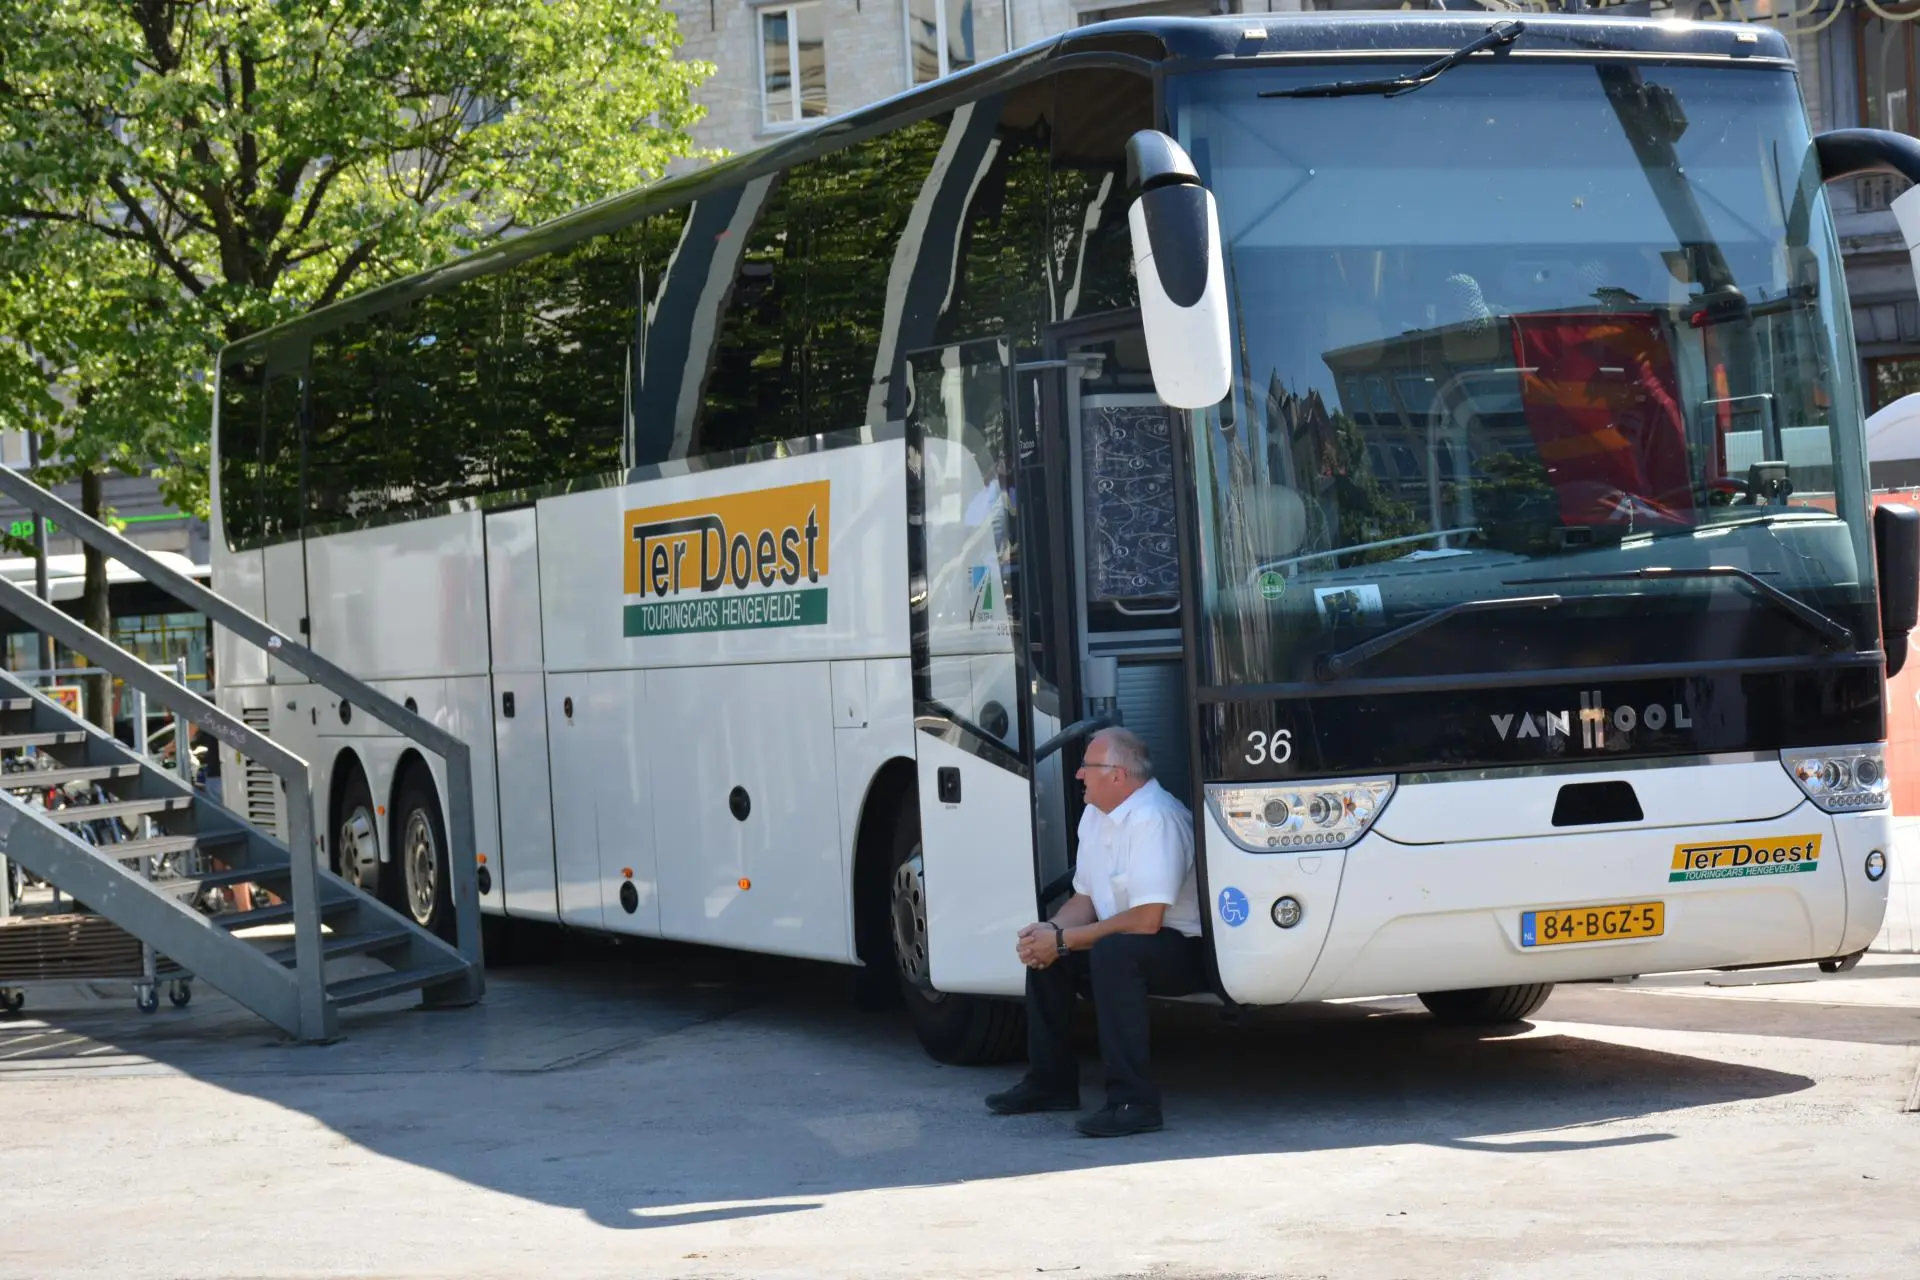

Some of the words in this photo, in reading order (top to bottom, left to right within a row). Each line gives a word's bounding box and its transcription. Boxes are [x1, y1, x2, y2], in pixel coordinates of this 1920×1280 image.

[633, 517, 698, 598] Ter
[700, 504, 819, 593] Doest
[641, 600, 718, 631] TOURINGCARS
[722, 593, 801, 626] HENGEVELDE
[1490, 710, 1571, 742] VAN
[1579, 690, 1693, 749] HOOL
[1245, 728, 1292, 765] 36
[1682, 847, 1727, 870] Ter
[1732, 842, 1814, 867] Doest
[1684, 867, 1744, 880] TOURINGCARS
[1745, 863, 1801, 876] HENGEVELDE
[1544, 908, 1656, 940] 84-BGZ-5
